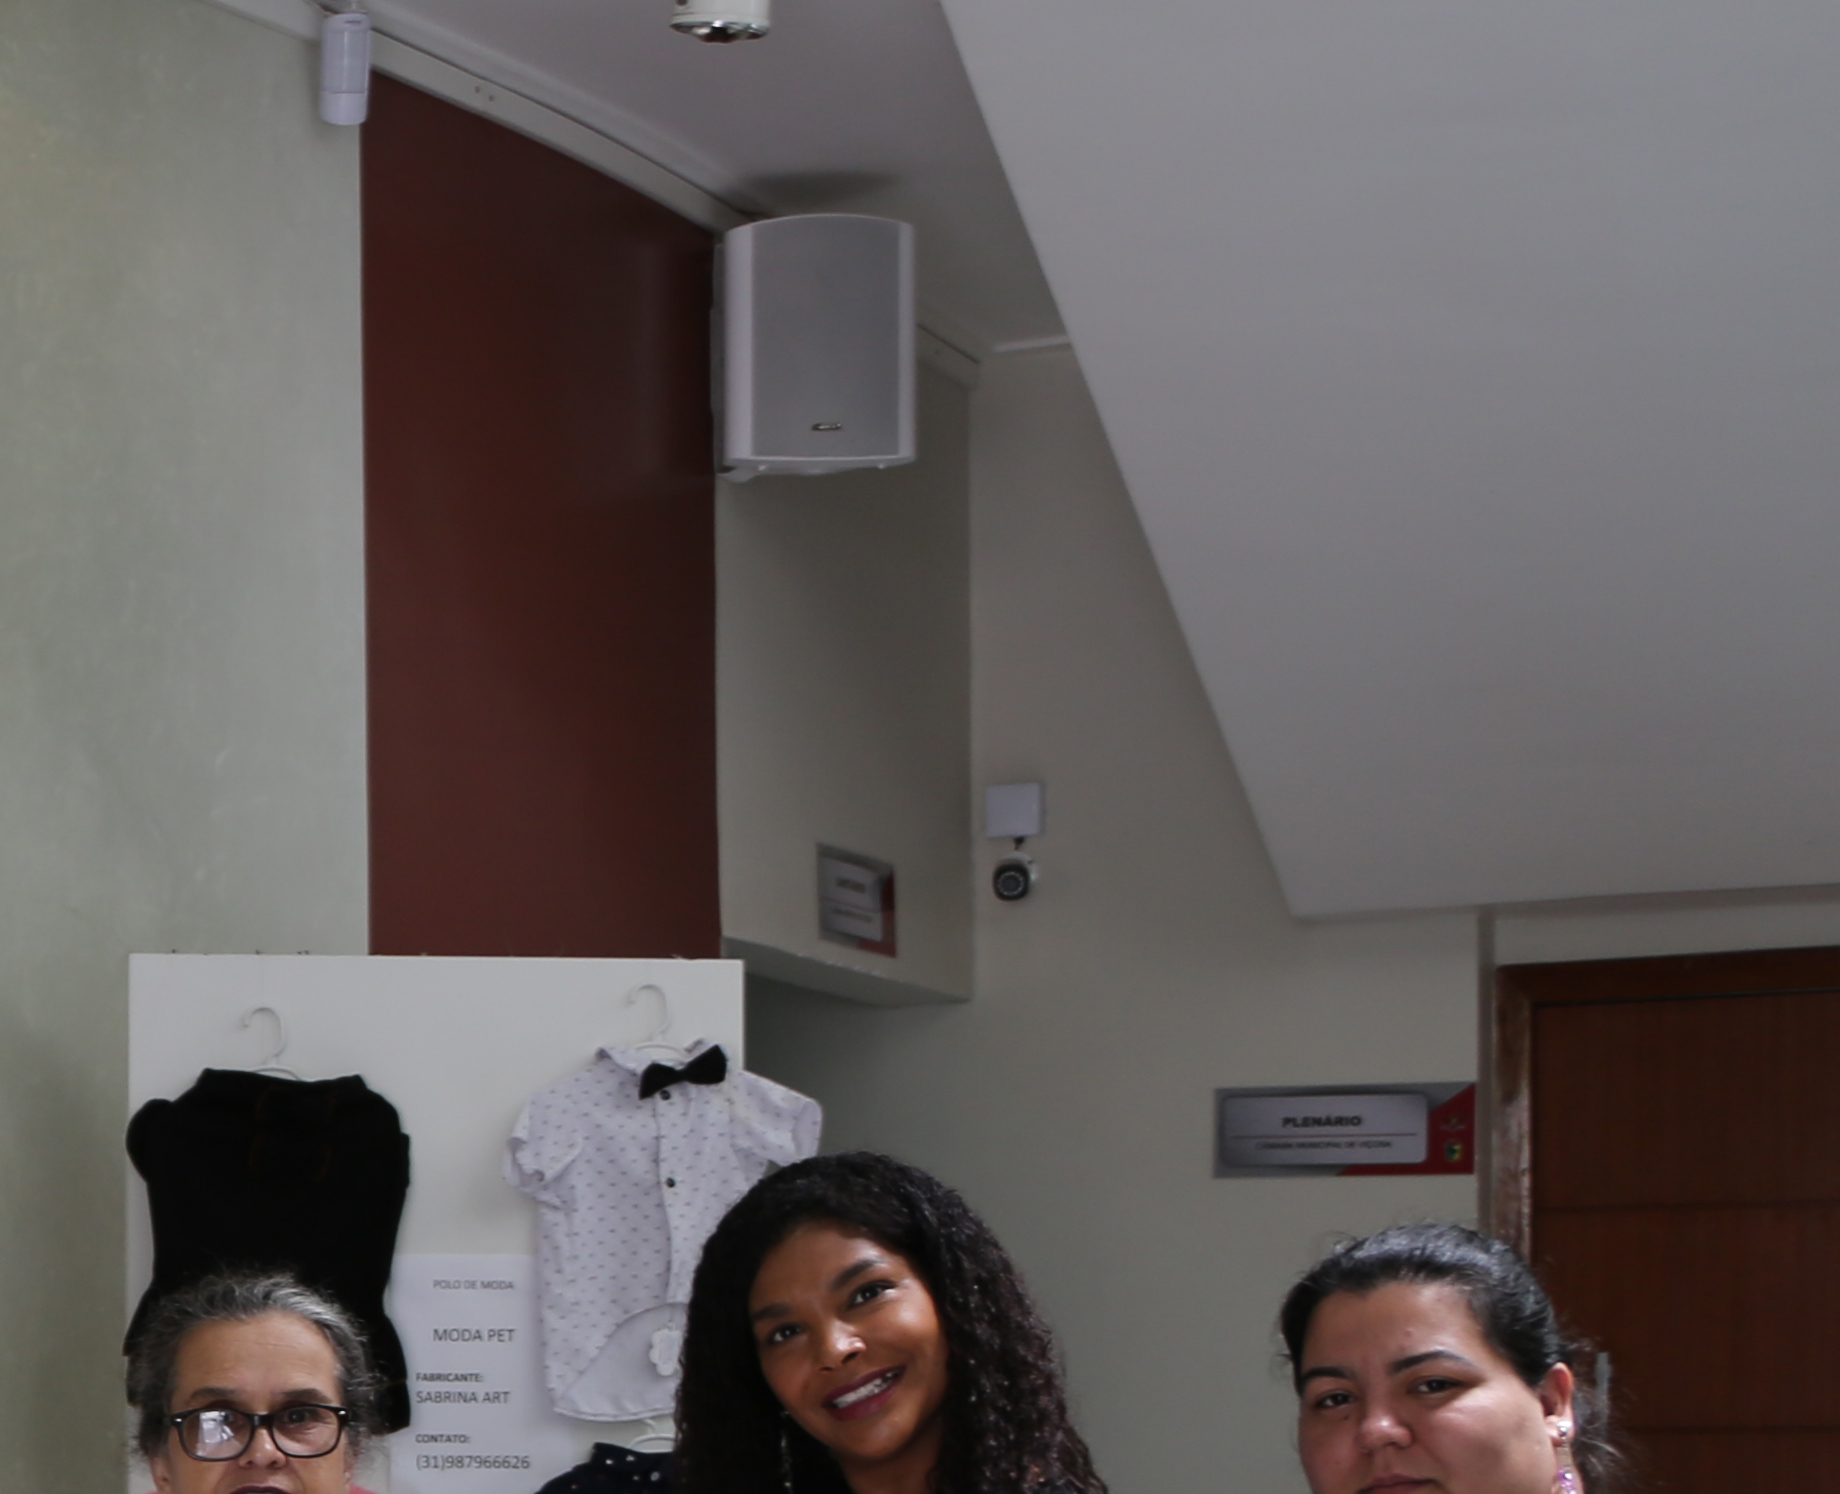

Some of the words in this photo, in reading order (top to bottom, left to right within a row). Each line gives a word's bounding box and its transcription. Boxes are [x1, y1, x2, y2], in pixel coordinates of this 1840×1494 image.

[1281, 1114, 1363, 1128] PLENÁRIO
[432, 1279, 462, 1290] POLO
[464, 1279, 478, 1290] DE
[480, 1279, 515, 1290] MODA
[432, 1328, 483, 1343] MODA
[486, 1328, 516, 1343] PET
[415, 1373, 484, 1383] FABRICANTE:
[416, 1390, 478, 1404] SABRINA
[482, 1390, 511, 1404] ART
[415, 1434, 471, 1444] CONTATO:
